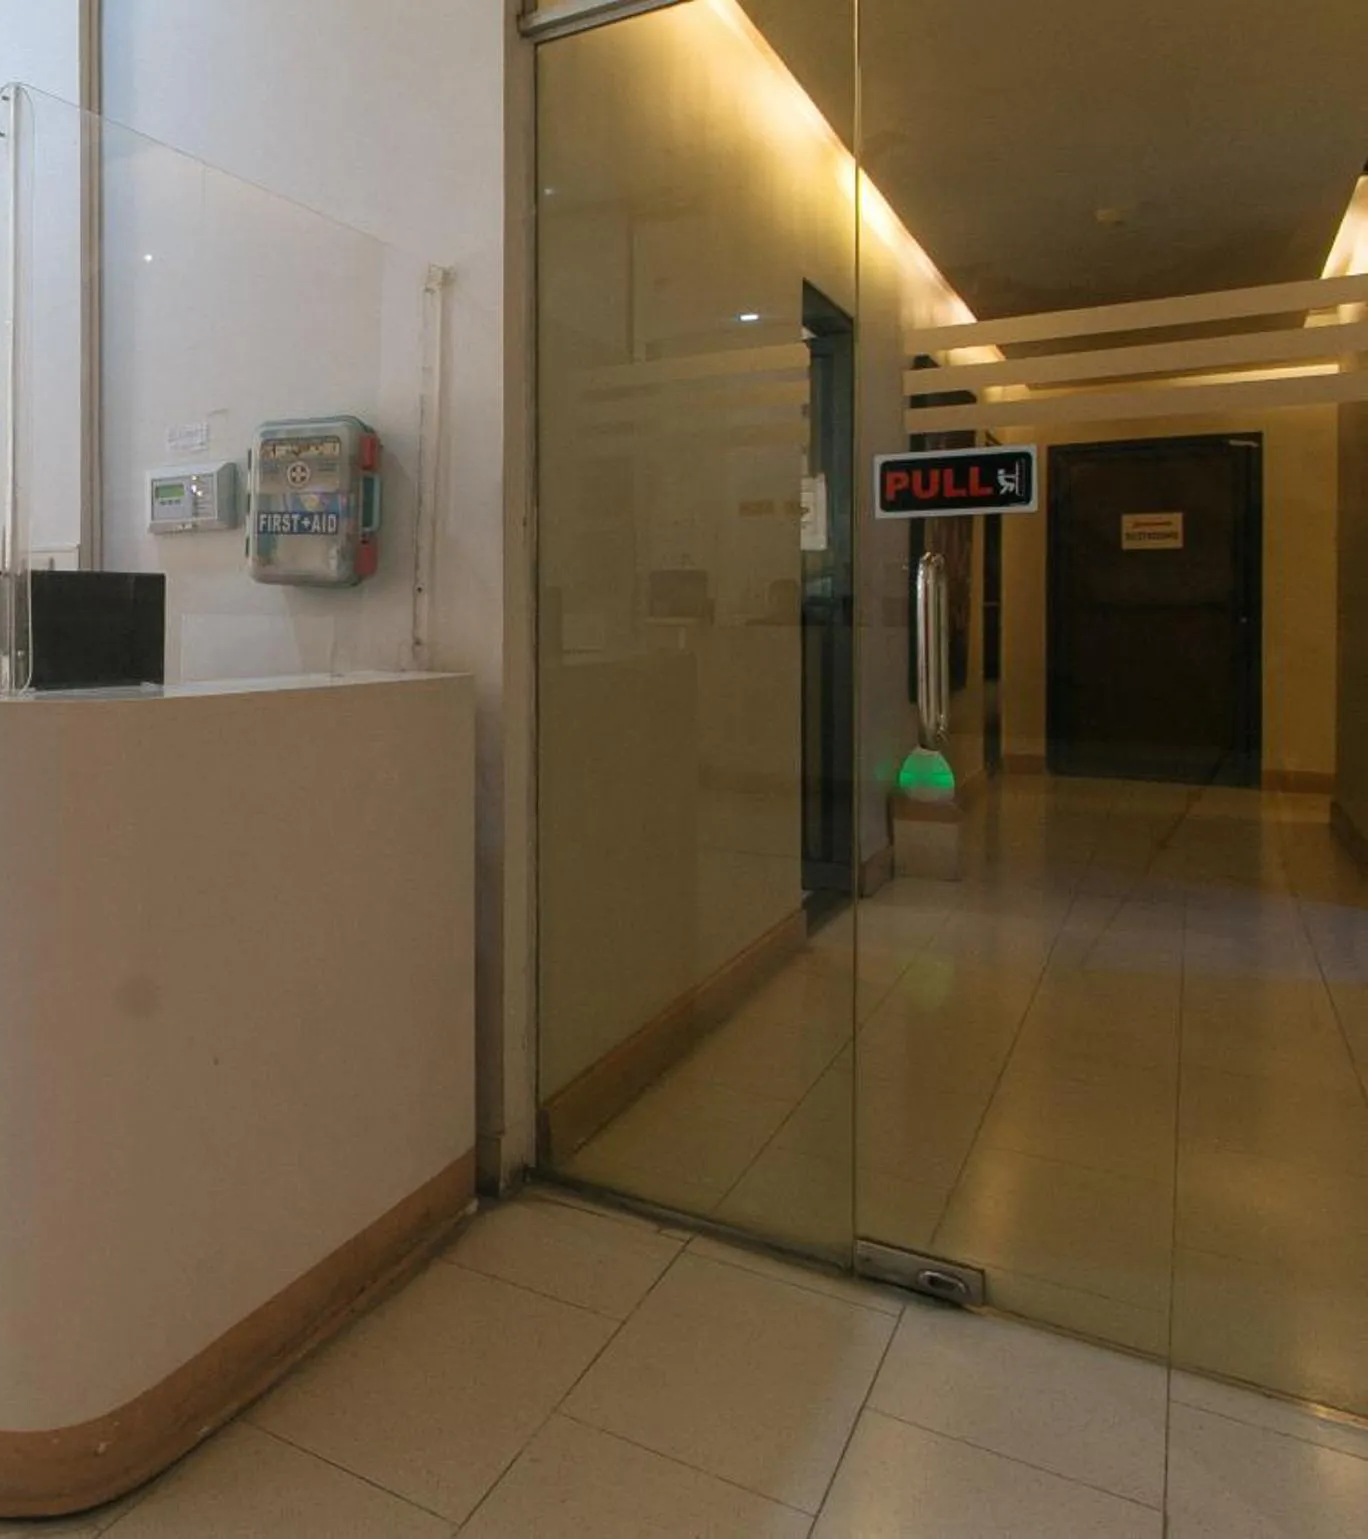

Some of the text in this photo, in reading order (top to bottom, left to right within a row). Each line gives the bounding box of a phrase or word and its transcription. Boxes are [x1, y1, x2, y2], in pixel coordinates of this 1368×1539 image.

[885, 466, 993, 502] PULL
[259, 513, 338, 532] FIRST AID
